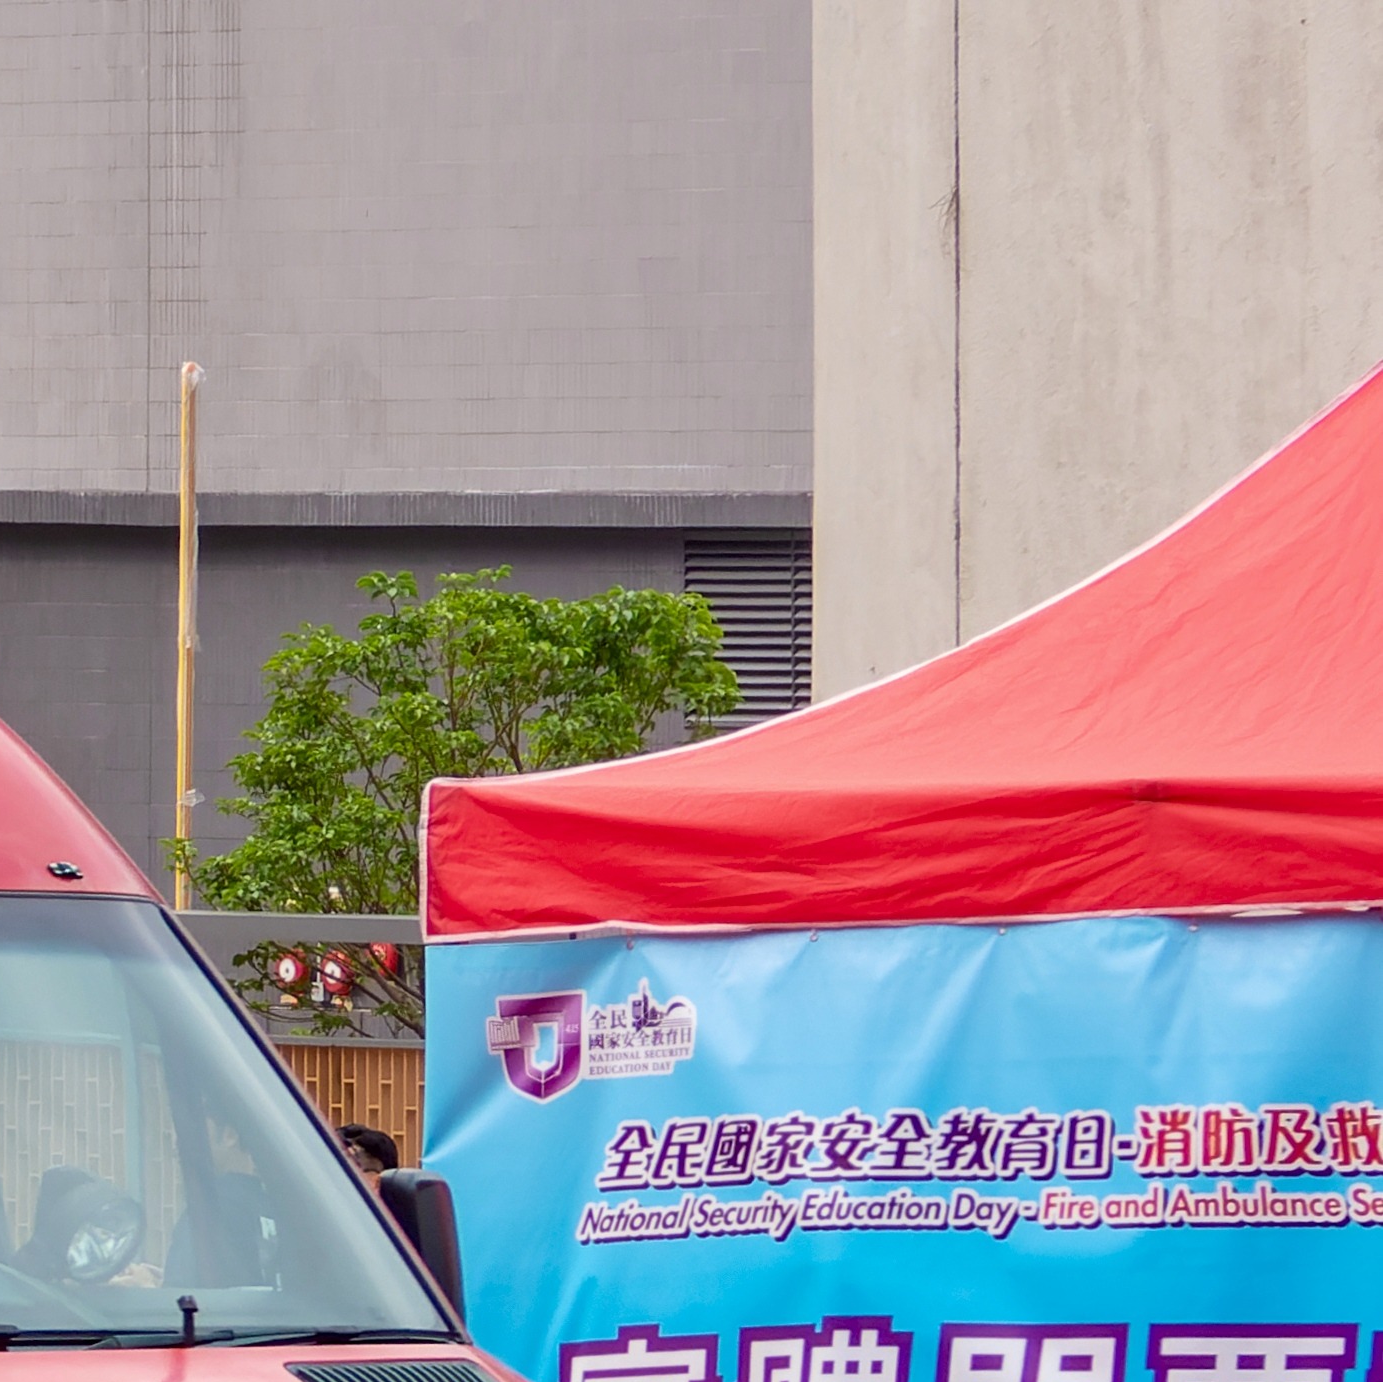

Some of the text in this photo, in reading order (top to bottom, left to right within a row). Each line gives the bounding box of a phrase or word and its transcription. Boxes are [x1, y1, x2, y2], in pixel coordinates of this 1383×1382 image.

[589, 1009, 627, 1030] 全民
[588, 1027, 692, 1051] 國家安全教育日
[589, 1046, 691, 1063] NATIONAL SECURITY
[589, 1060, 672, 1076] EDUCATION DAY
[580, 1197, 689, 1236] National
[693, 1196, 795, 1235] Security
[801, 1190, 941, 1221] Education
[952, 1193, 1013, 1228] Day
[1042, 1191, 1095, 1220] Fire
[1105, 1186, 1159, 1219] and
[1169, 1185, 1342, 1217] Ambulance
